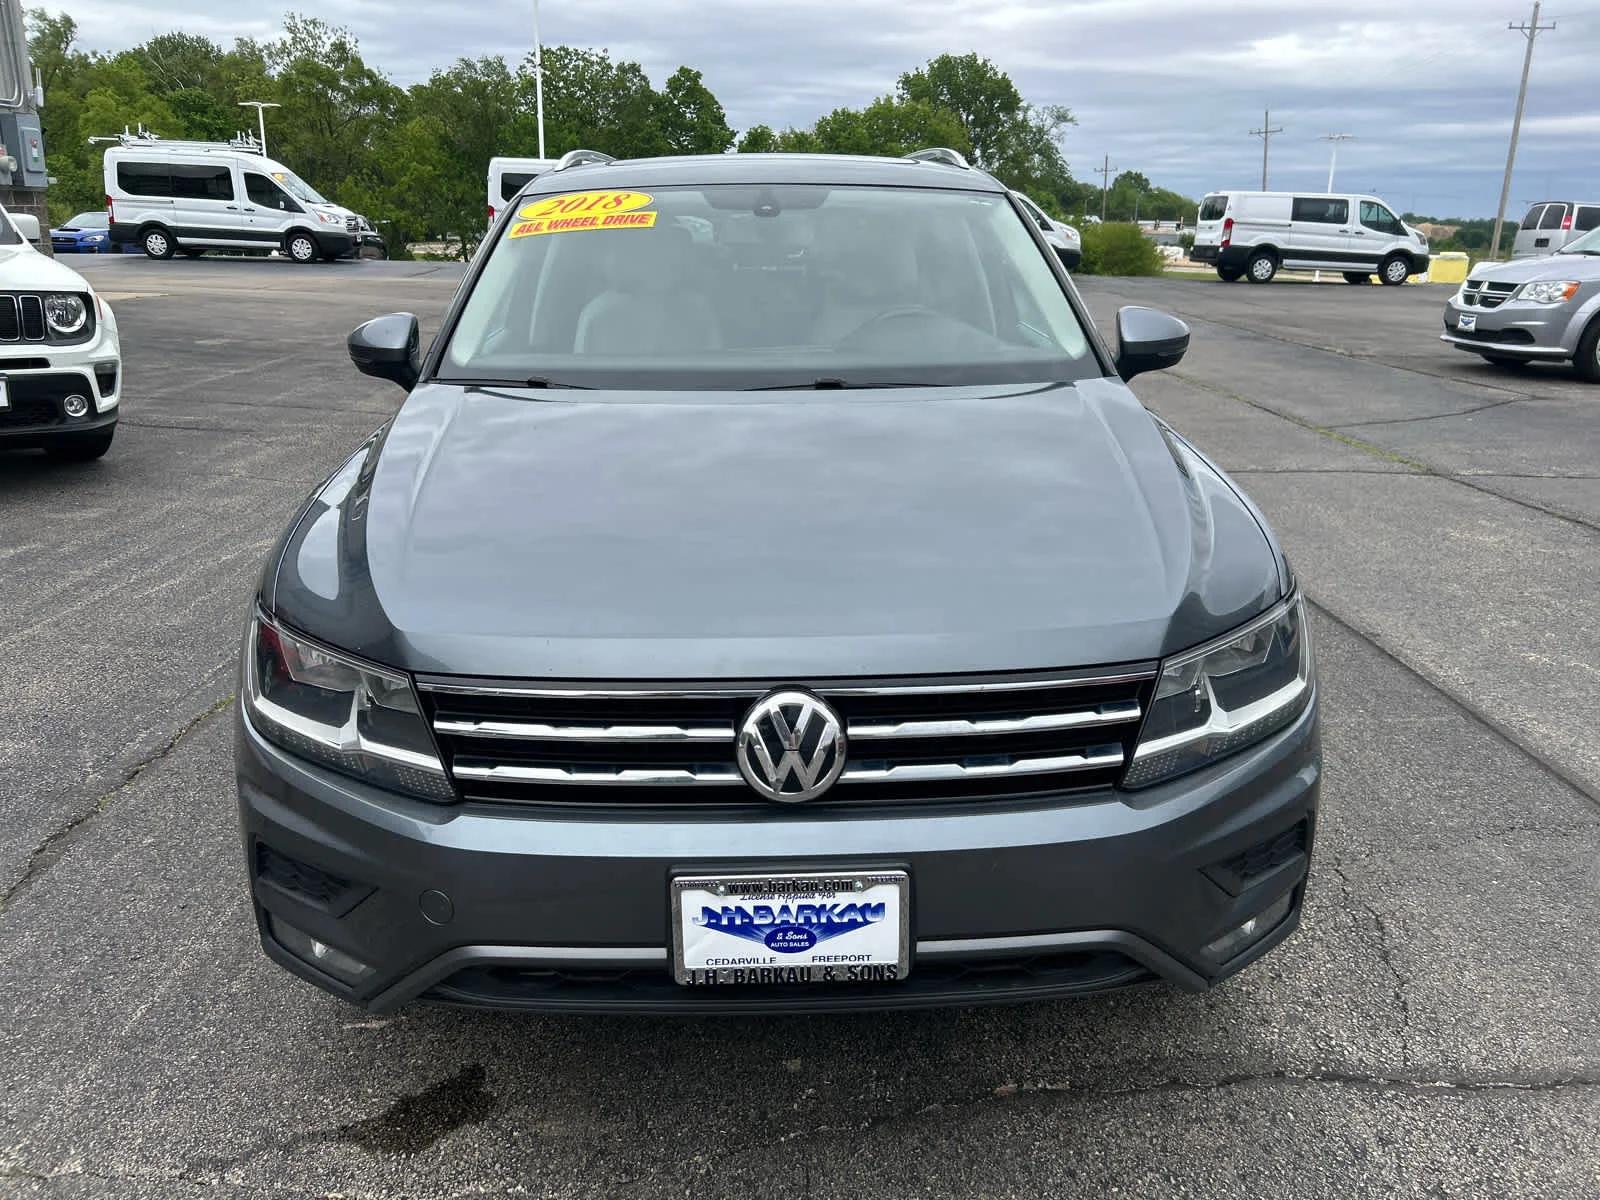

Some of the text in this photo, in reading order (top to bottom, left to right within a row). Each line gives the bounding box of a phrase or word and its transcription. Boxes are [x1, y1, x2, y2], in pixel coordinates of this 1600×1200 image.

[536, 193, 632, 218] 2018
[516, 213, 651, 236] ALL WHEEL DRIVE
[728, 879, 854, 894] www.barkau.com
[786, 931, 808, 940] Sons
[706, 954, 872, 966] CEDARVILLE FREEPORT
[733, 966, 812, 984] BARKAU
[822, 966, 837, 982] &
[847, 964, 898, 980] SONS
